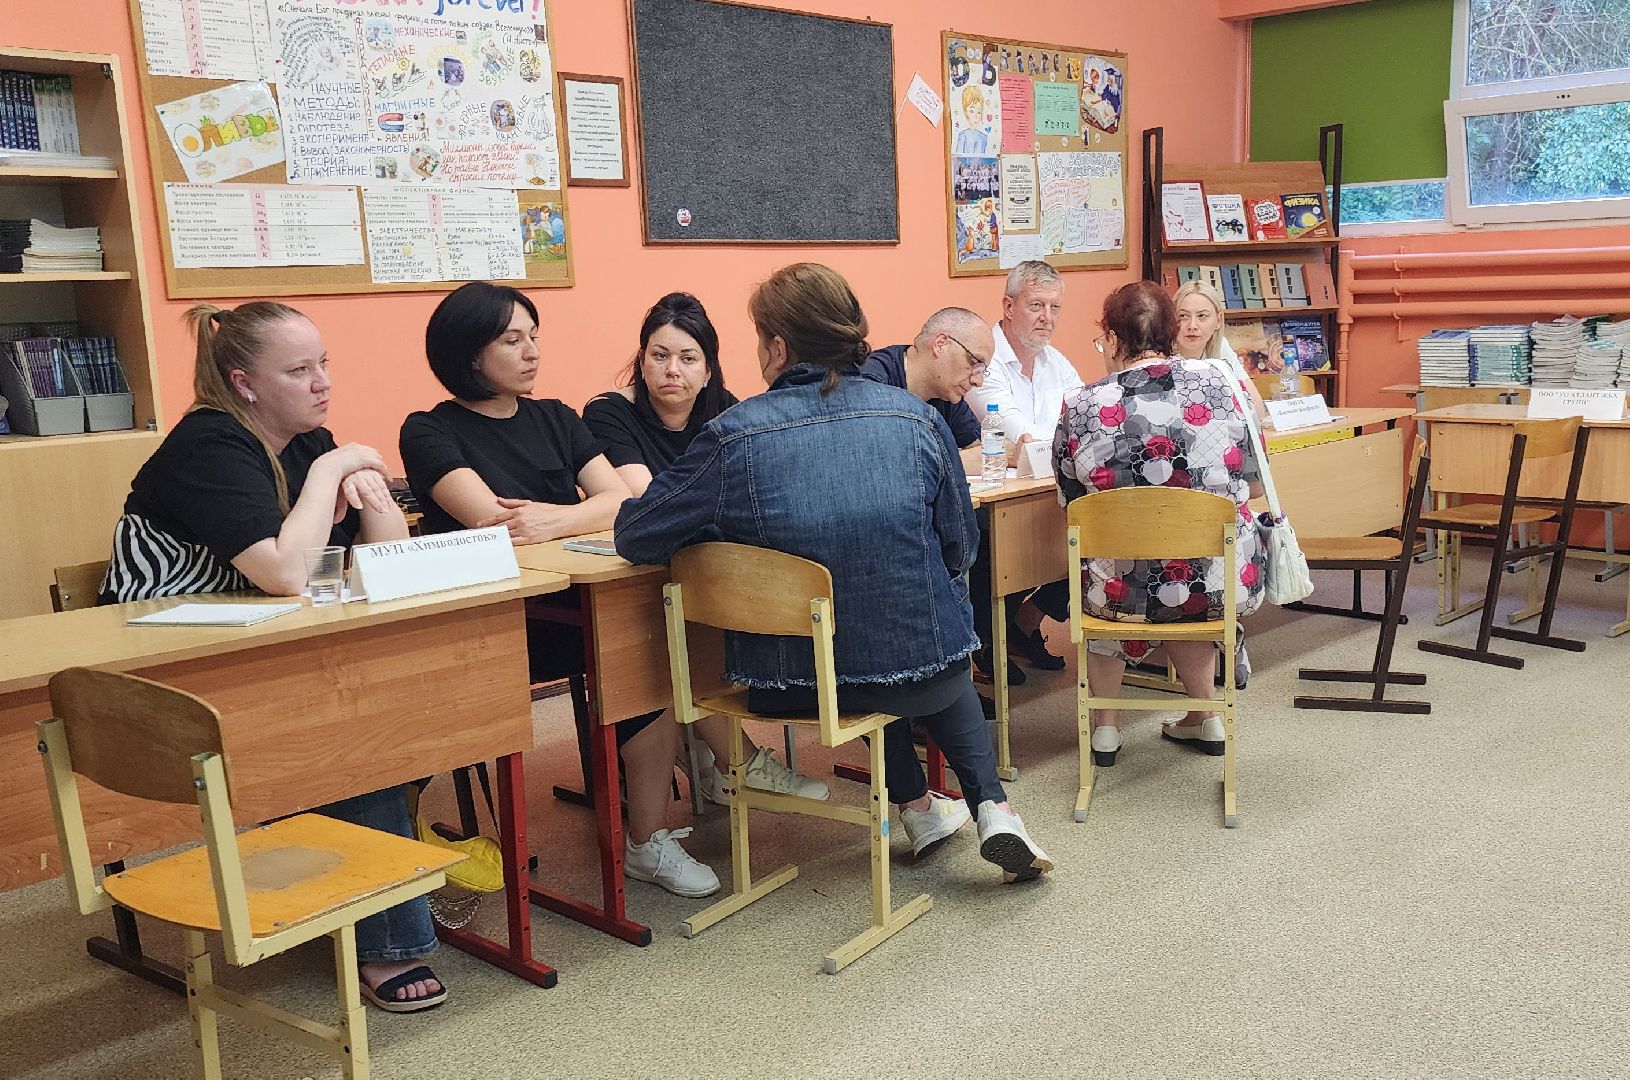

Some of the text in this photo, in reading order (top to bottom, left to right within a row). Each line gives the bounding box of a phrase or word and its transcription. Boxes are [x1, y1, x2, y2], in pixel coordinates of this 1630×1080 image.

[368, 45, 416, 76] ТЕПЛОВЫЕ
[479, 47, 514, 86] ЗВУКОВЫЕ
[311, 83, 362, 95] НАУЧНЫЕ
[375, 97, 436, 112] МАГНИТНЫЕ
[458, 102, 487, 140] ЯДЕРНЫЕ
[496, 94, 531, 142] КВАНТОВЫЕ
[385, 129, 430, 142] ЯВЛЕНИЯ!
[1284, 197, 1320, 208] ФИЗИКА
[370, 533, 498, 559] МУП «Химводосток»
